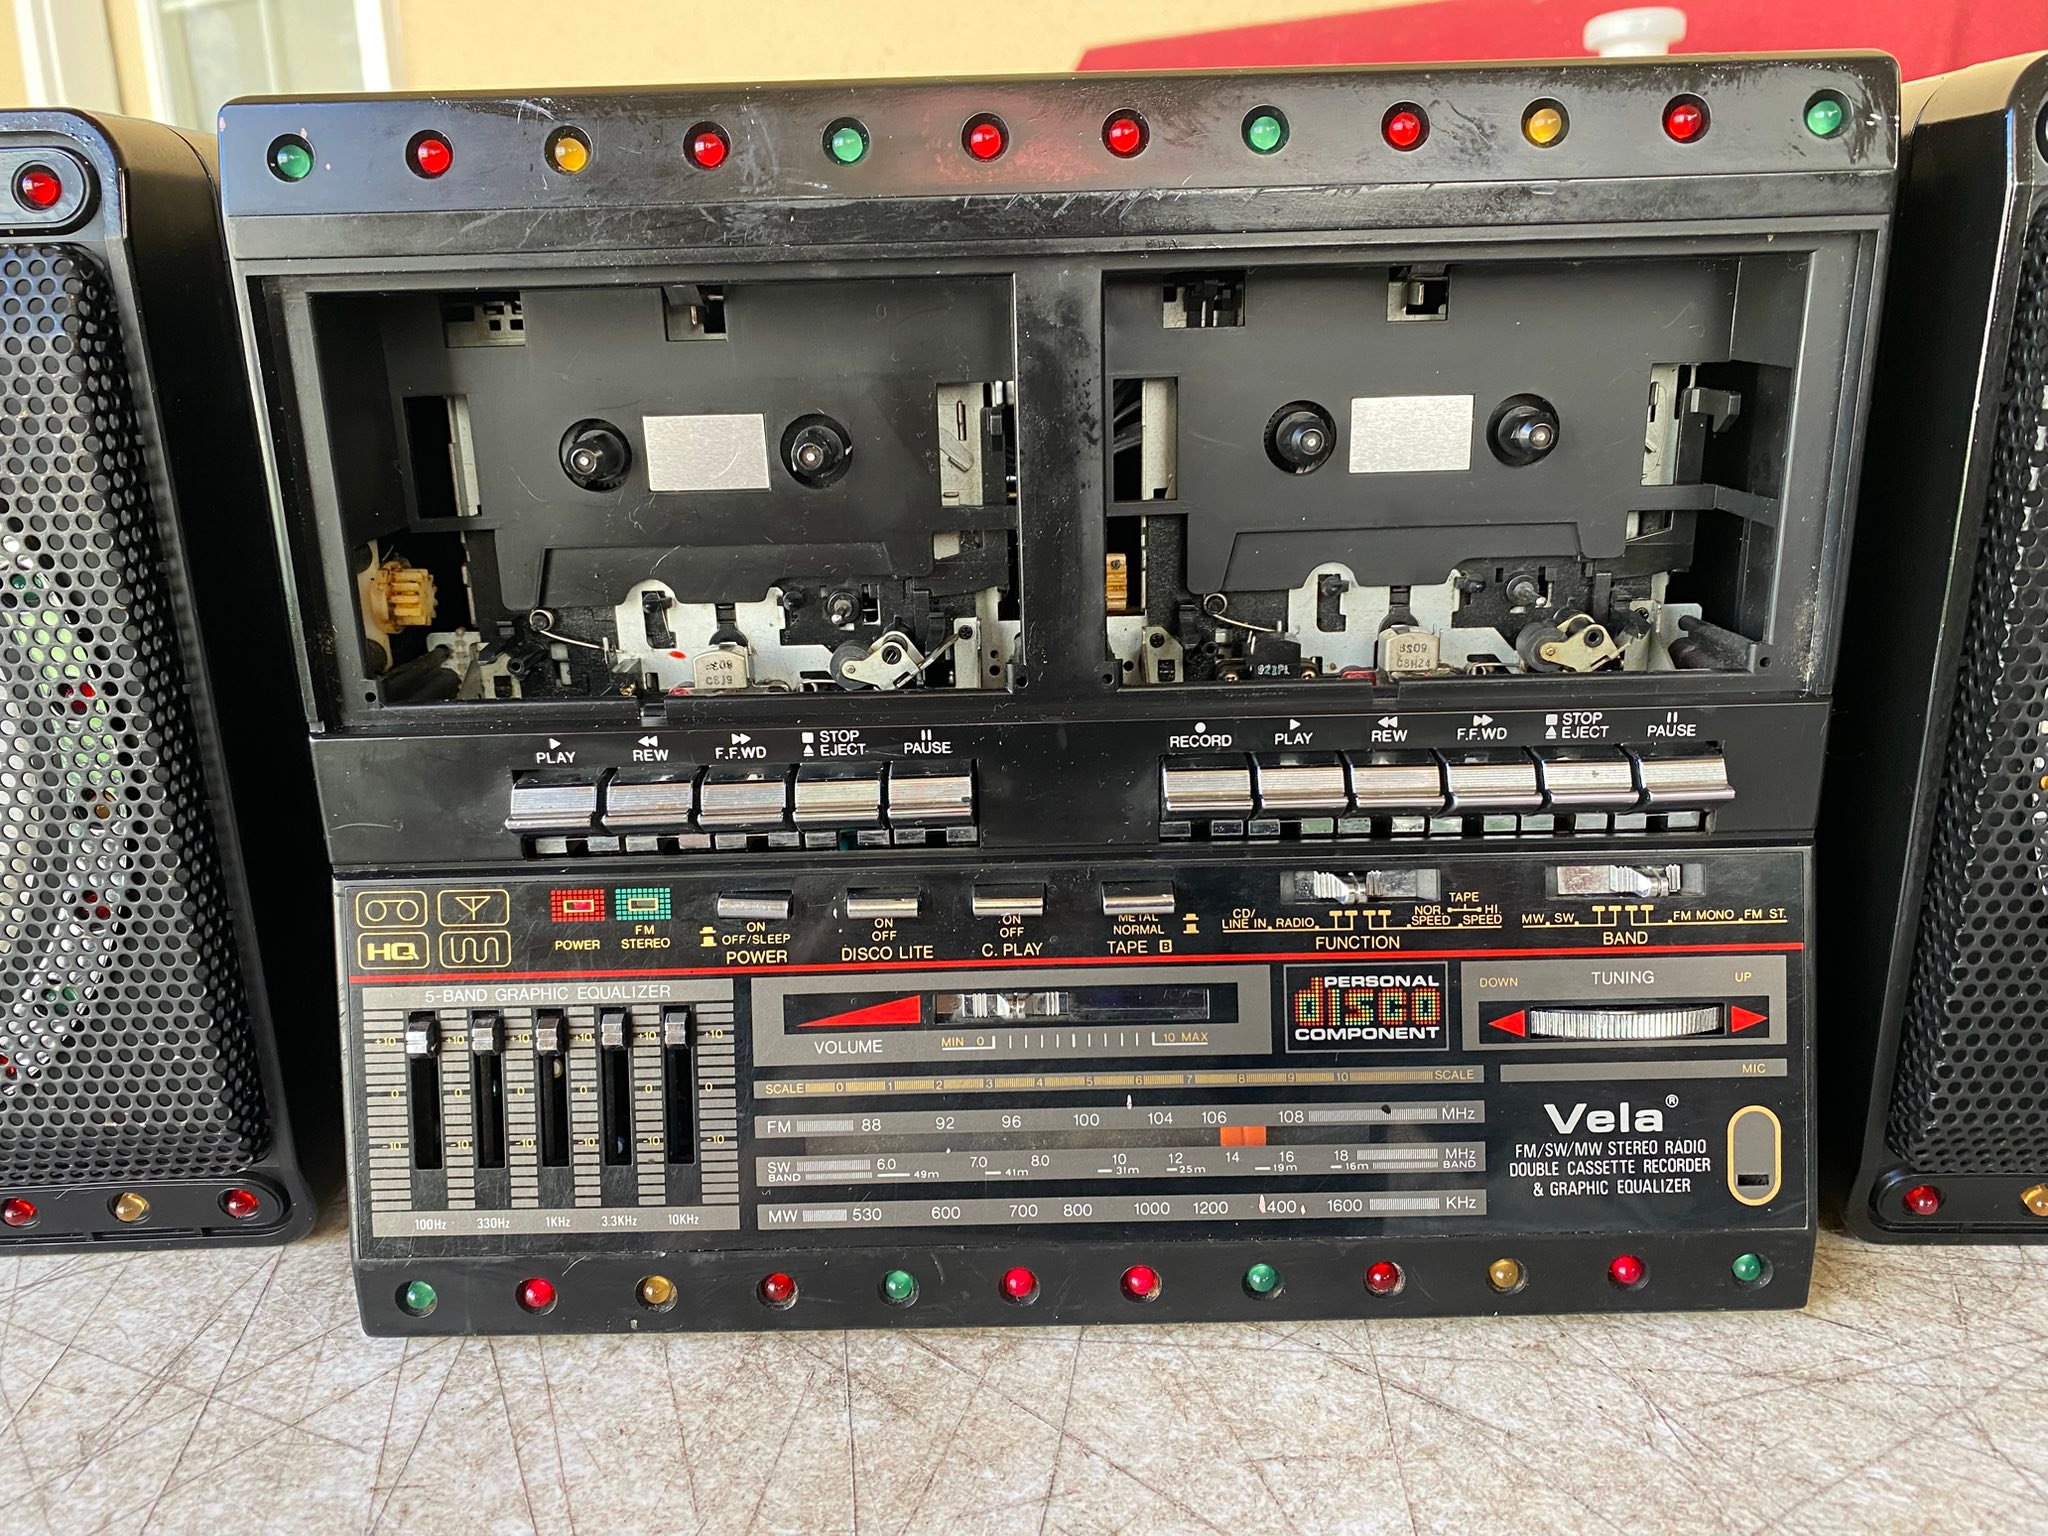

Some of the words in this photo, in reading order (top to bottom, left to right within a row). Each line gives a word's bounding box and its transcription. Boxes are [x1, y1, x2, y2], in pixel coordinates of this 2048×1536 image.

[1562, 712, 1603, 726] STOP
[820, 730, 860, 743] STOP
[1371, 729, 1408, 743] REW
[1457, 727, 1508, 741] F.F.WD
[1562, 725, 1609, 739] EJECT
[1647, 723, 1696, 738] PAUSE
[1169, 734, 1232, 748] RECORD
[1274, 732, 1313, 746] PLAY
[633, 749, 669, 761] REW
[715, 745, 767, 759] F.F.WD
[820, 743, 866, 757] EJECT
[903, 741, 951, 755] PAUSE
[536, 751, 576, 764] PLAY
[1449, 892, 1479, 902] TAPE
[1118, 913, 1159, 922] METAL
[1233, 909, 1255, 919] CD/
[1415, 905, 1444, 916] NOR.
[1673, 910, 1691, 921] FM
[1696, 909, 1735, 920] MONO
[1744, 909, 1762, 919] FM
[1769, 908, 1786, 919] ST.
[874, 918, 893, 929] ON
[1002, 913, 1022, 925] ON
[1222, 919, 1250, 929] LINE
[1254, 918, 1267, 928] IN
[1276, 917, 1315, 928] RADIO
[1411, 915, 1451, 926] SPEED
[1462, 914, 1502, 925] SPEED
[635, 925, 655, 935] FM
[747, 922, 766, 932] ON
[999, 927, 1024, 938] OFF
[1113, 924, 1165, 935] NORMAL
[621, 937, 671, 949] STEREO
[721, 933, 791, 945] OFF/SLEEP
[872, 931, 897, 942] OFF
[1315, 936, 1400, 950] FUNCTION
[1603, 931, 1648, 945] BAND
[367, 942, 419, 961] HQ
[555, 940, 600, 951] POWER
[981, 944, 998, 957] C.
[1003, 943, 1043, 956] PLAY
[1107, 941, 1148, 954] TAPE
[726, 950, 788, 965] POWER
[841, 946, 893, 961] DISCO
[899, 945, 934, 959] LITE
[1324, 975, 1440, 988] PERSONAL
[1479, 977, 1518, 988] DOWN
[1591, 971, 1655, 985] TUNING
[1735, 972, 1751, 982] UP
[425, 989, 487, 1002] 5-BAND
[495, 986, 569, 1000] GRAPHIC
[578, 985, 670, 998] EQUALIZER
[374, 1036, 396, 1046] +10
[446, 1035, 465, 1045] +10
[511, 1034, 530, 1043] +10
[574, 1033, 592, 1042] +10
[638, 1031, 657, 1041] +10
[704, 1030, 723, 1039] +10
[1163, 1033, 1175, 1042] 10
[1181, 1032, 1209, 1042] MAX
[1295, 1027, 1440, 1041] COMPONENT
[814, 1040, 883, 1054] VOLUME
[941, 1037, 964, 1047] MIN
[976, 1036, 985, 1046] 0
[1742, 1063, 1766, 1074] MIC
[765, 1083, 804, 1094] SCALE
[835, 1082, 844, 1091] 0
[888, 1082, 892, 1091] 1
[935, 1081, 943, 1090] 2
[985, 1079, 993, 1089] 3
[1035, 1078, 1043, 1087] 4
[1086, 1077, 1093, 1086] 5
[1135, 1076, 1142, 1085] 6
[1186, 1075, 1192, 1084] 7
[1238, 1074, 1246, 1083] 8
[1287, 1073, 1295, 1082] 9
[1336, 1072, 1348, 1081] 10
[1435, 1070, 1474, 1080] SCALE
[391, 1089, 399, 1099] 0
[454, 1088, 463, 1098] 0
[517, 1086, 525, 1096] 0
[580, 1085, 588, 1095] 0
[645, 1084, 653, 1094] 0
[705, 1082, 713, 1092] 0
[767, 1121, 791, 1133] FM
[861, 1119, 881, 1131] 88
[935, 1117, 955, 1130] 92
[1001, 1115, 1021, 1128] 96
[1073, 1113, 1100, 1126] 100
[1148, 1112, 1173, 1124] 104
[1202, 1111, 1227, 1124] 106
[1278, 1110, 1304, 1123] 108
[1442, 1107, 1475, 1120] MHz
[1544, 1102, 1664, 1135] Vela
[1515, 1141, 1602, 1158] FM/SW/MW
[1608, 1140, 1658, 1156] STEREO
[1665, 1139, 1707, 1155] RADIO
[767, 1162, 790, 1174] SW
[1112, 1153, 1127, 1165] 10
[1168, 1152, 1183, 1164] 12
[1225, 1151, 1239, 1162] 14
[1279, 1151, 1294, 1163] 16
[1334, 1150, 1349, 1161] 18
[1445, 1148, 1476, 1159] MHz
[1509, 1162, 1559, 1177] DOUBLE
[1567, 1160, 1636, 1175] CASSETTE
[1643, 1158, 1711, 1173] RECORDER
[768, 1174, 801, 1182] BAND
[913, 1170, 939, 1178] 49m
[1116, 1166, 1140, 1174] 31m
[1179, 1165, 1206, 1174] 25m
[1273, 1164, 1297, 1172] 19m
[1345, 1162, 1369, 1170] 16m
[1443, 1160, 1476, 1169] BAND
[1533, 1182, 1544, 1197] &
[1550, 1180, 1609, 1196] GRAPHIC
[1617, 1178, 1691, 1194] EQUALIZER
[768, 1210, 798, 1223] MW
[852, 1208, 882, 1221] 530
[931, 1207, 961, 1220] 600
[1009, 1205, 1038, 1218] 700
[1063, 1204, 1093, 1217] 800
[1134, 1202, 1170, 1215] 1000
[1193, 1201, 1229, 1214] 1200
[1327, 1199, 1363, 1212] 1600
[1446, 1196, 1477, 1209] KHz
[414, 1218, 447, 1231] 100Hz
[477, 1218, 510, 1230] 330Hz
[545, 1216, 570, 1229] 1KHz
[601, 1215, 637, 1228] 3.3KHz
[668, 1214, 699, 1226] 10KHz
